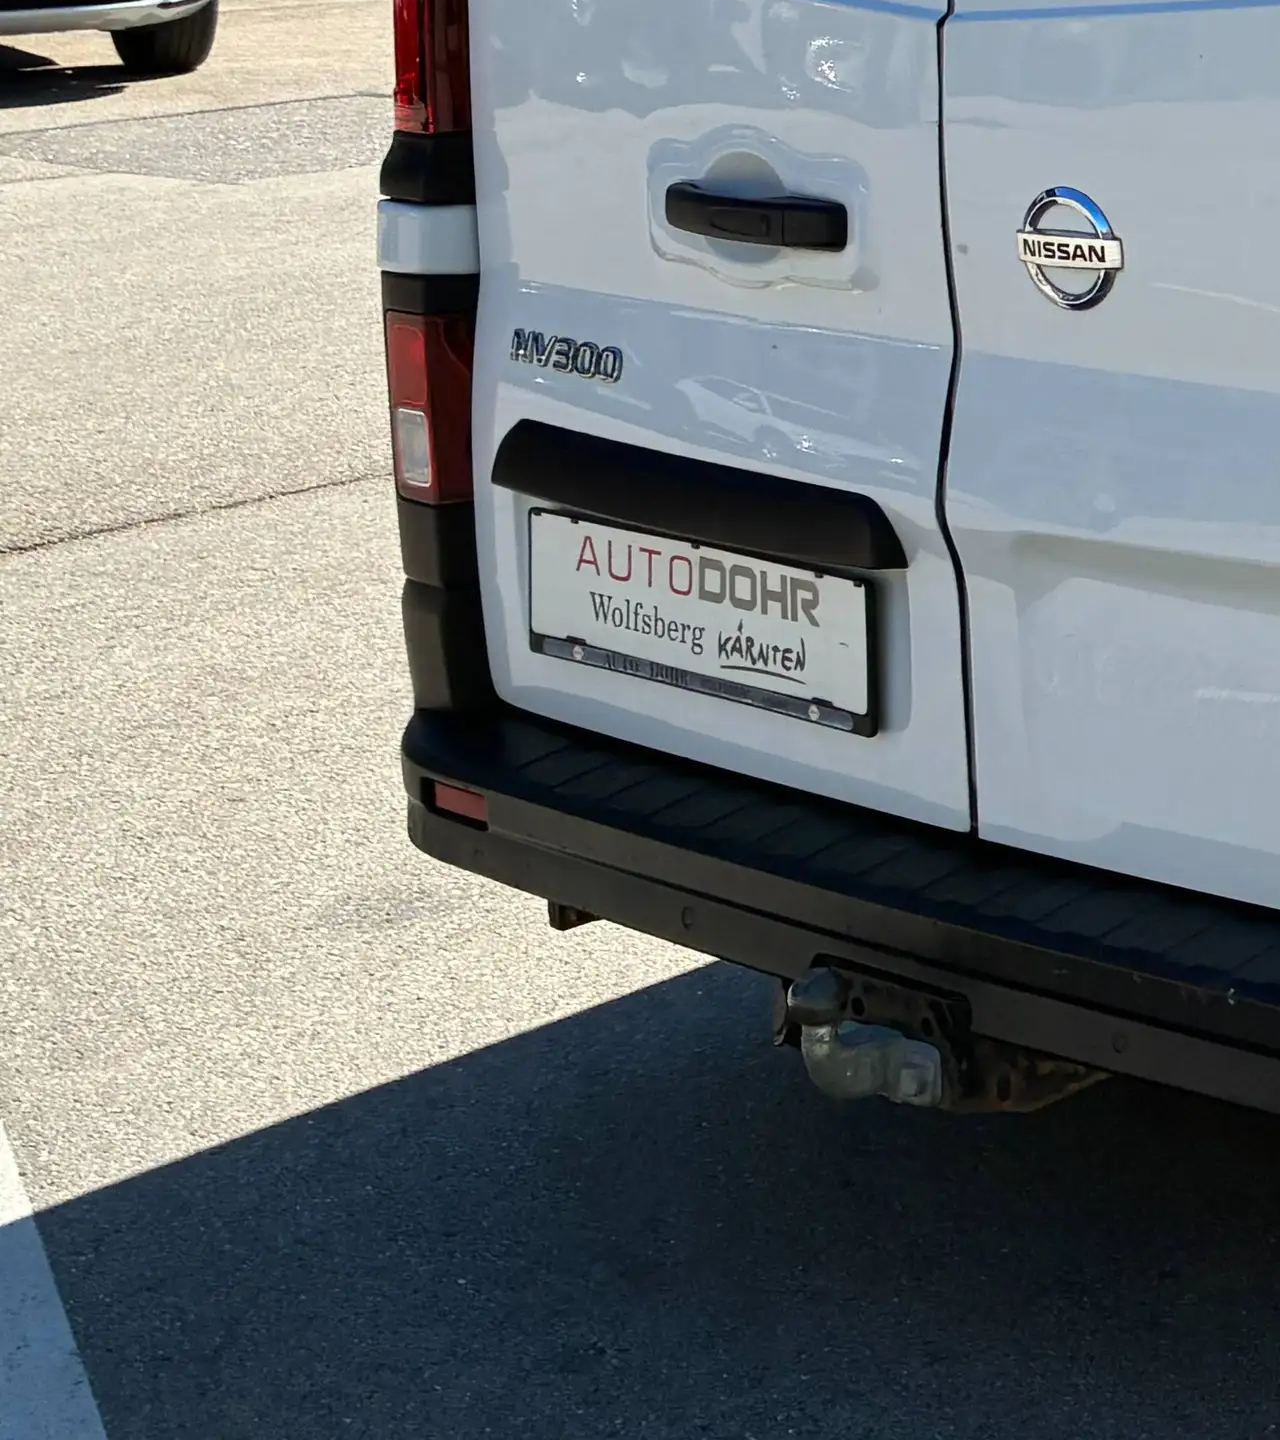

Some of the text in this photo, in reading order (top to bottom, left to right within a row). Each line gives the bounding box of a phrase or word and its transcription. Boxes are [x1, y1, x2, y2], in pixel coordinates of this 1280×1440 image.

[1023, 238, 1106, 263] NISSAN
[510, 328, 624, 384] NV300
[589, 591, 705, 655] Wolfsberg
